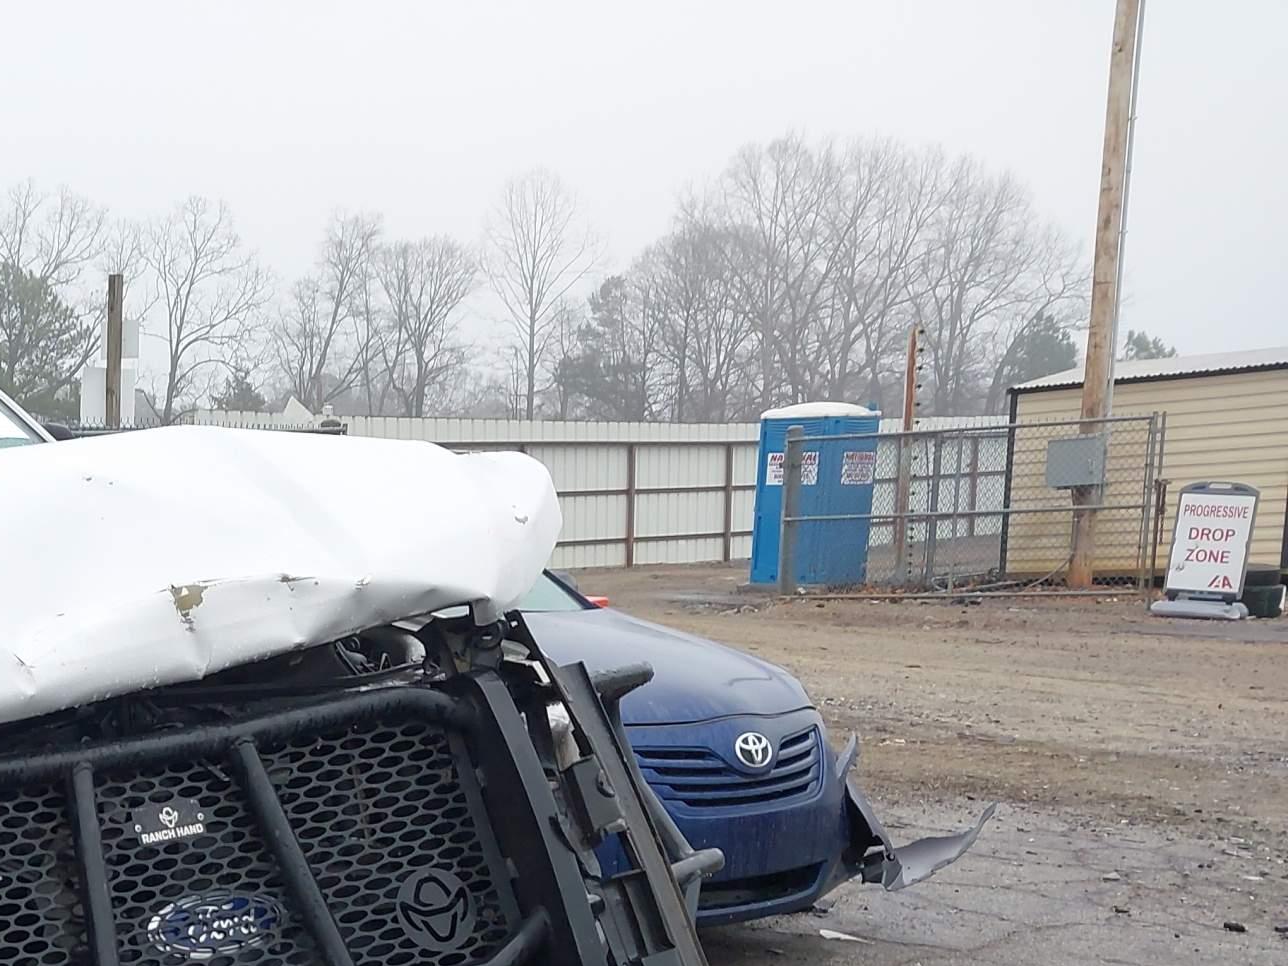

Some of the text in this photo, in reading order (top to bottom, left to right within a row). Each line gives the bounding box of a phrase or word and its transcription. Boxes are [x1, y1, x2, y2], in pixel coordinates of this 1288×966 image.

[1183, 503, 1249, 519] PROGRESSIVE
[1188, 526, 1236, 542] DROP
[1184, 548, 1231, 564] ZONE
[141, 823, 204, 845] RANCH HAND
